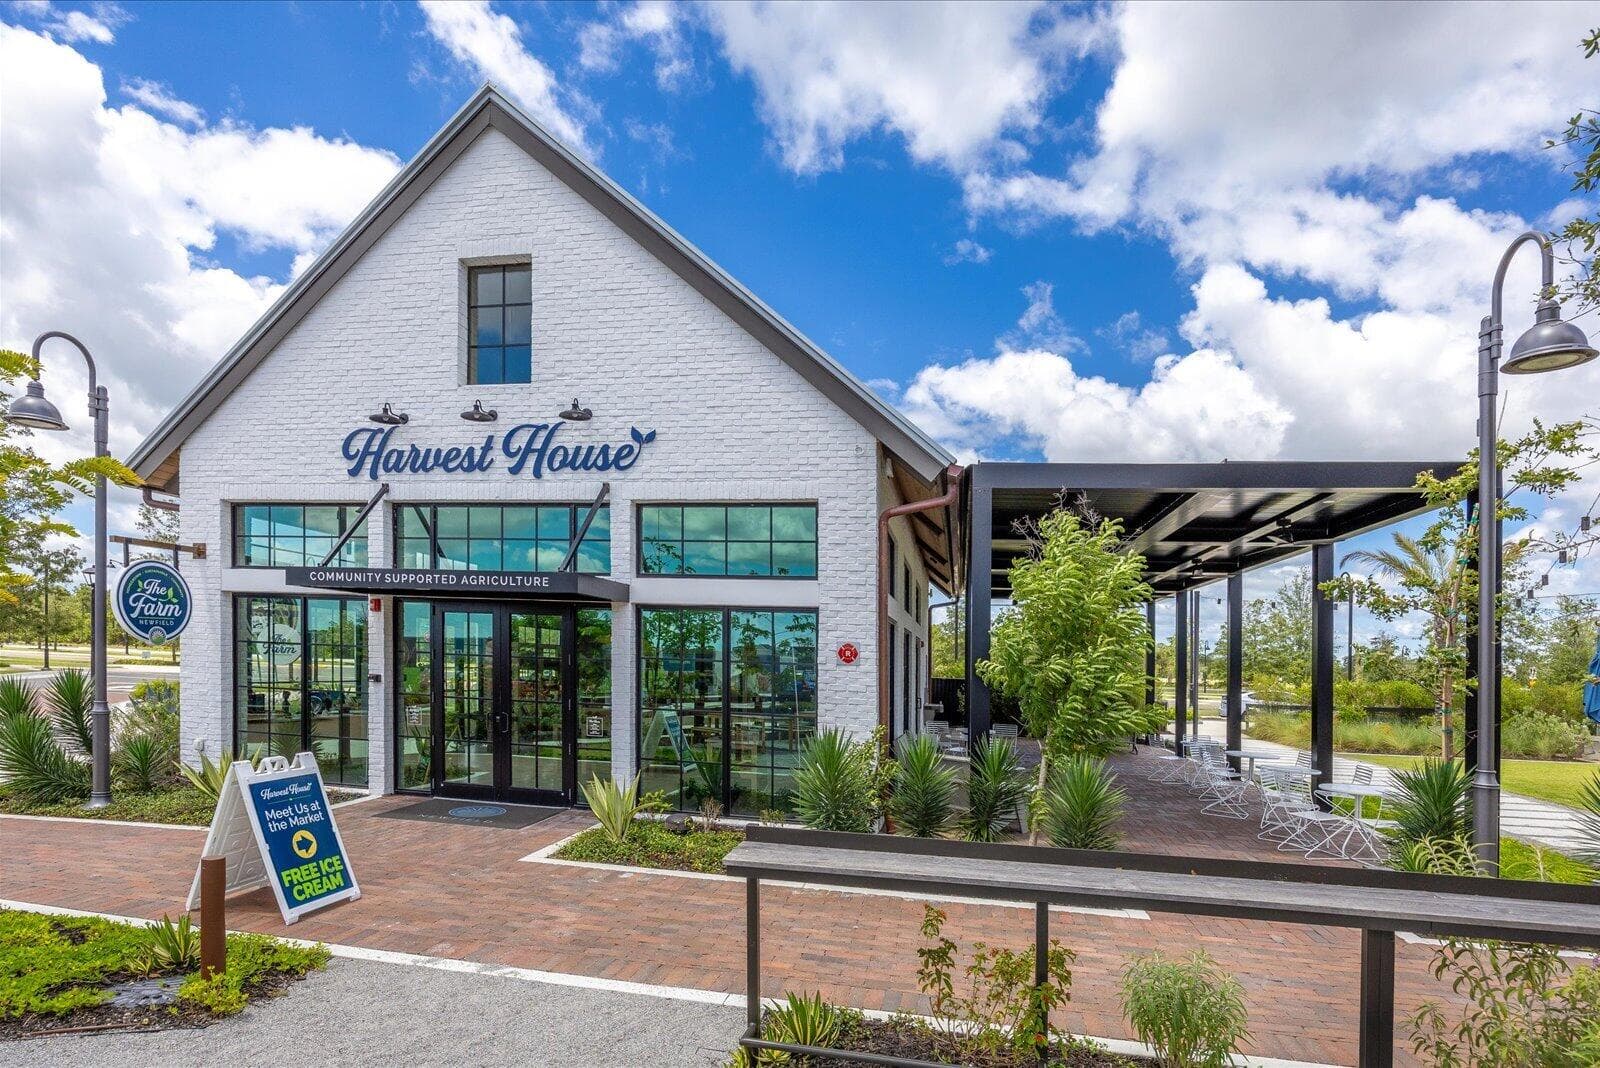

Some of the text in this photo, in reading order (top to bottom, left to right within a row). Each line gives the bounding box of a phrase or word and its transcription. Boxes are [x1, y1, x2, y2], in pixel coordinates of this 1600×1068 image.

[342, 421, 641, 481] Harvest House
[144, 579, 167, 594] The
[309, 571, 550, 587] COMMUNITY SUPPORTED AGRICULTURE
[130, 593, 181, 618] Farm
[260, 784, 311, 800] Harvest House
[264, 800, 321, 823] Meet Us at
[268, 811, 325, 833] the Market
[281, 855, 344, 887] FREE ICE
[294, 873, 344, 901] CREAM
